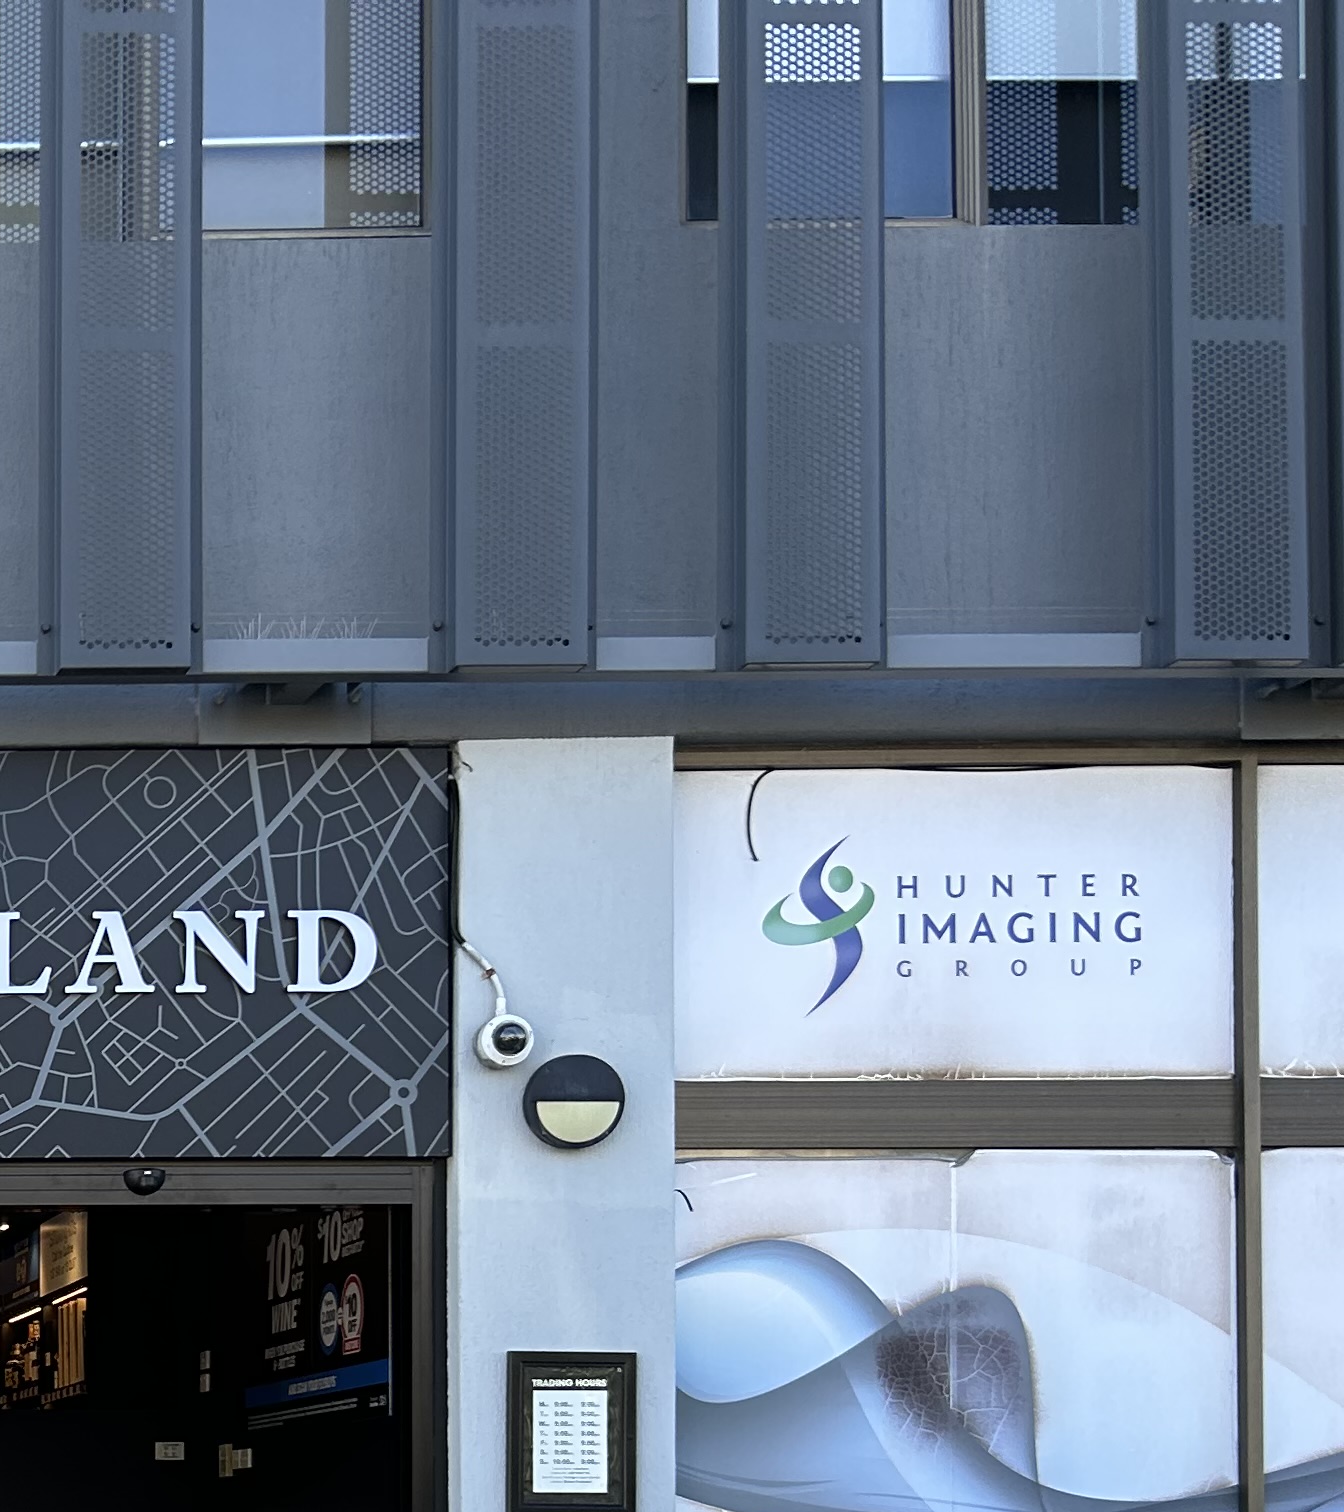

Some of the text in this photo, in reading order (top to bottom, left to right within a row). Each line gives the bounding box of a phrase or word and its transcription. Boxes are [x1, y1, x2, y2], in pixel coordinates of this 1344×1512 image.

[897, 873, 1139, 898] HUNTER
[898, 911, 1143, 944] IMAGING
[897, 959, 1142, 978] GROUP
[532, 1379, 607, 1387] TRADING HOURS
